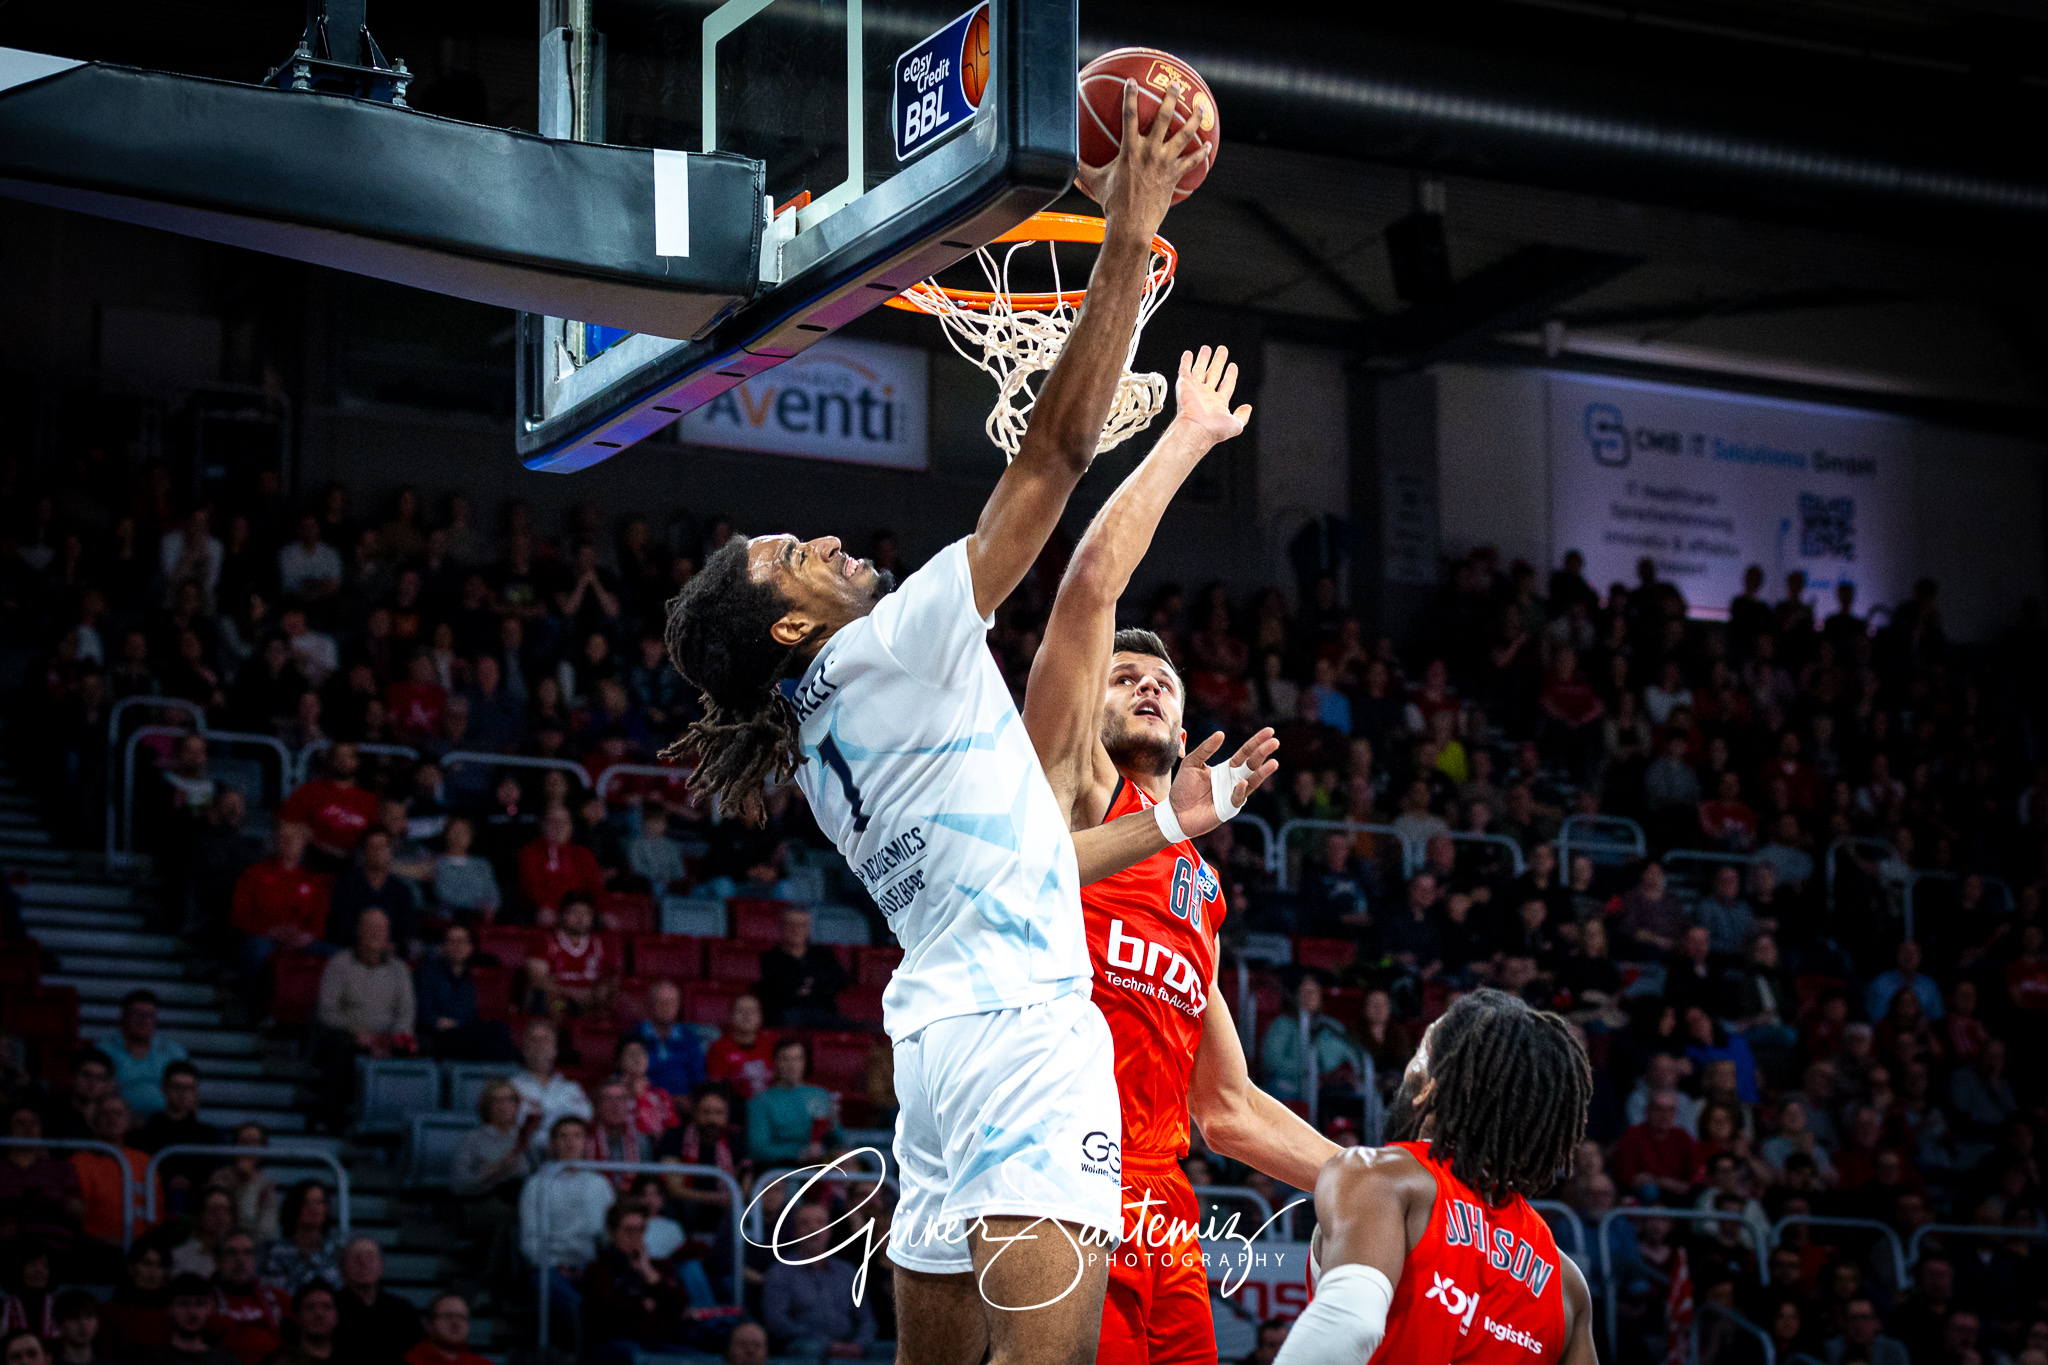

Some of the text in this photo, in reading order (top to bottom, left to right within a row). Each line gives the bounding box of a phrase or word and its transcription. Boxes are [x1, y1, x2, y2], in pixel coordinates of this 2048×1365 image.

[917, 58, 950, 93] Credit
[1153, 73, 1185, 101] BL
[904, 85, 949, 147] BBL
[815, 730, 870, 832] 1
[1105, 970, 1155, 996] Technik
[1446, 1199, 1553, 1298] JOHSON
[1484, 1316, 1543, 1354] logistics
